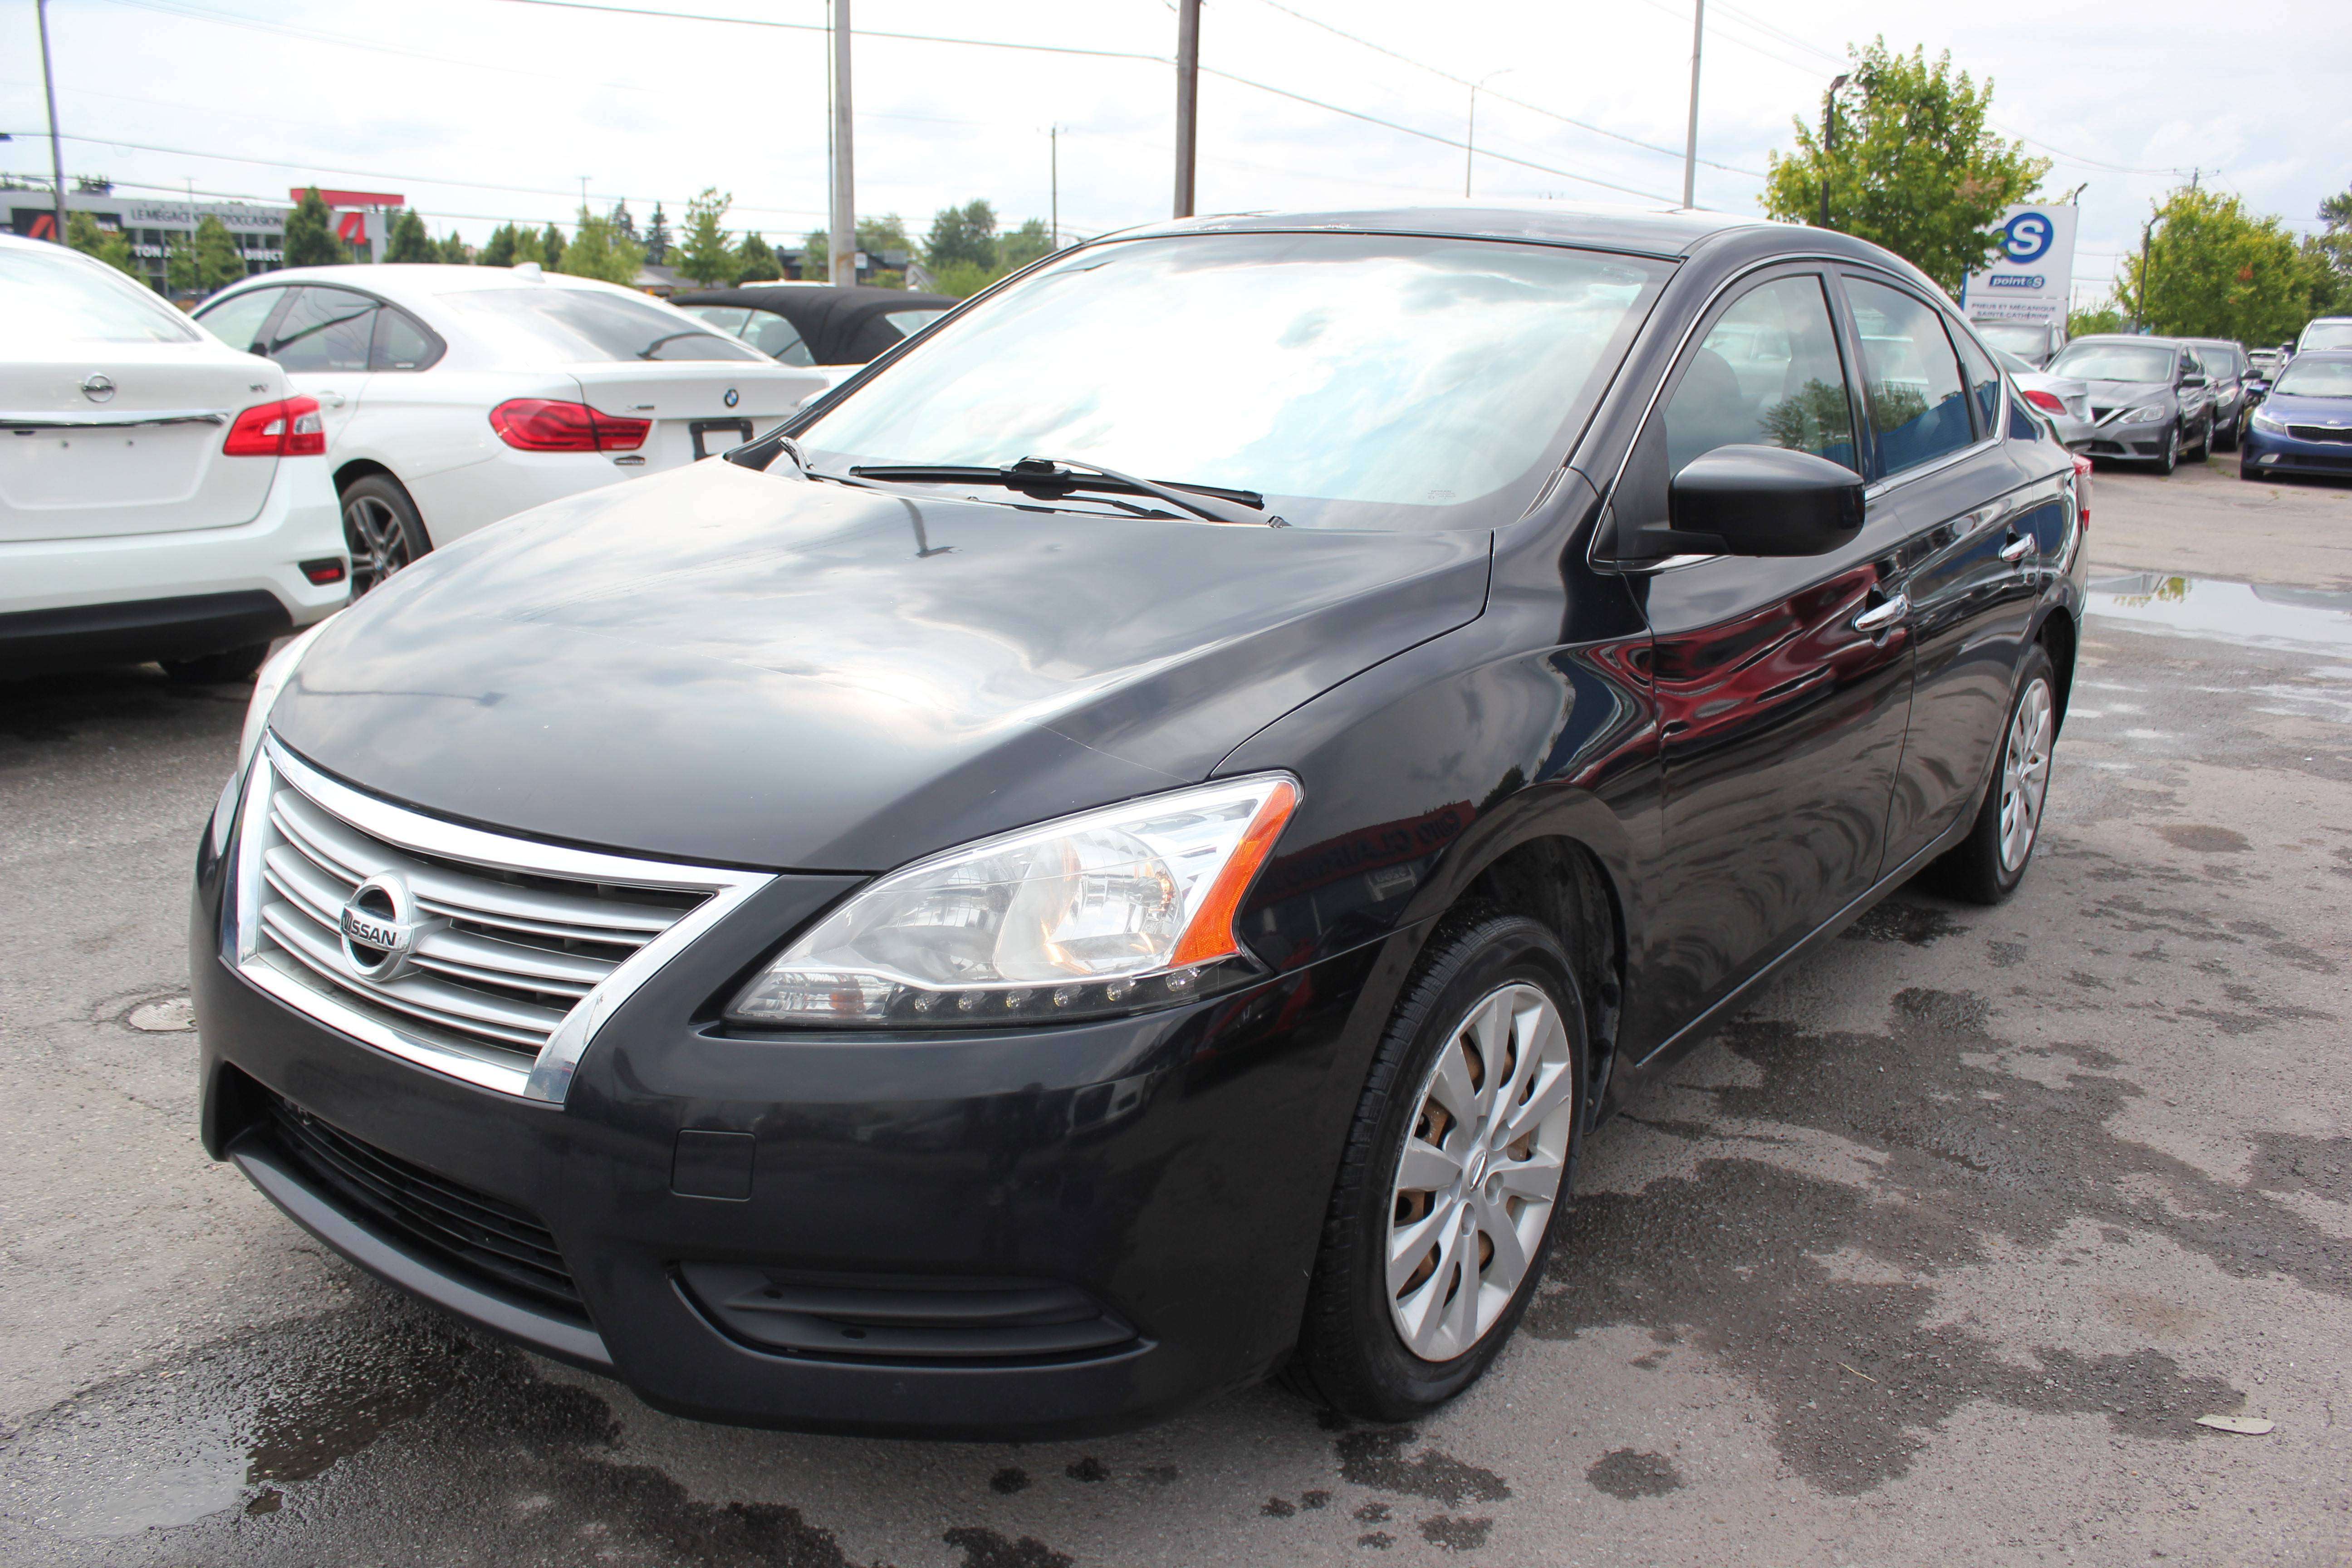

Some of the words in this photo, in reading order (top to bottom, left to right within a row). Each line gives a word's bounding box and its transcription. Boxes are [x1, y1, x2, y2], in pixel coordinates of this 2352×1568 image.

[2007, 219, 2044, 256] S
[1993, 277, 2027, 287] point
[342, 916, 397, 946] NISSAN
